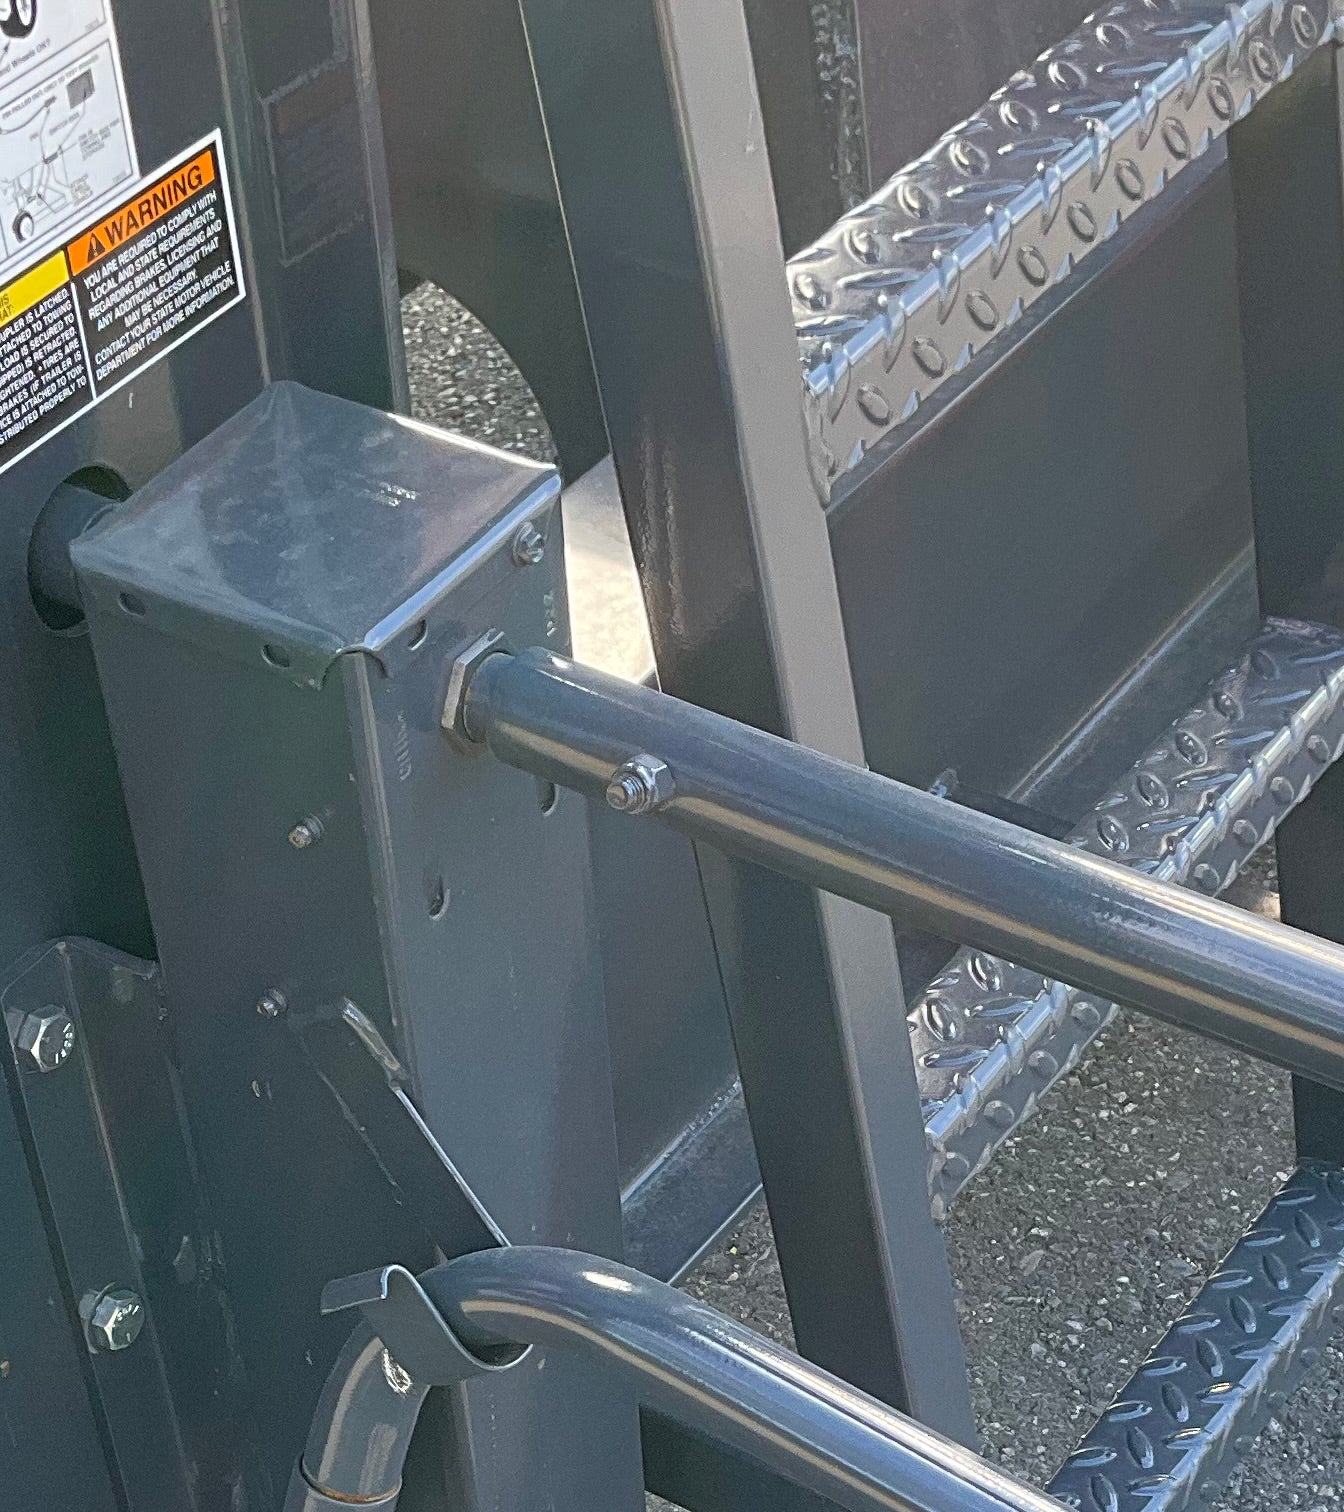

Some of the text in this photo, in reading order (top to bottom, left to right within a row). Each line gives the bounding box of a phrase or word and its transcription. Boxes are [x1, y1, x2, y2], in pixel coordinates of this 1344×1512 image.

[83, 188, 217, 290] YOU ARE REQUIRED TO COMPLY WITH
[104, 162, 202, 249] WARNING
[88, 279, 134, 321] REGARDING
[166, 229, 205, 266] LICENSING
[205, 218, 222, 239] AND
[90, 206, 215, 303] LOCAL AND STATE REQUIREMENTS
[96, 236, 219, 331] ANY ADDITIONAL EQUIPMENT THAT
[124, 267, 198, 328] MAY BE NECESSARY.
[0, 349, 20, 372] LOAD
[20, 343, 28, 357] IS
[29, 318, 64, 351] SECURED
[64, 311, 74, 327] TO
[24, 355, 32, 369] IS
[33, 324, 76, 362] RETRACTED.
[26, 310, 33, 324] IS
[34, 286, 69, 319] LATCHED.
[32, 319, 42, 335] TO
[43, 298, 72, 327] TOWING
[94, 260, 231, 366] CONTACT YOUR STATE MOTOR VEHICLE
[96, 273, 234, 381] DEPARTMENT FOR MORE INFORMATION.
[29, 379, 40, 396] (IF
[40, 356, 72, 386] TRAILER
[73, 349, 81, 363] IS
